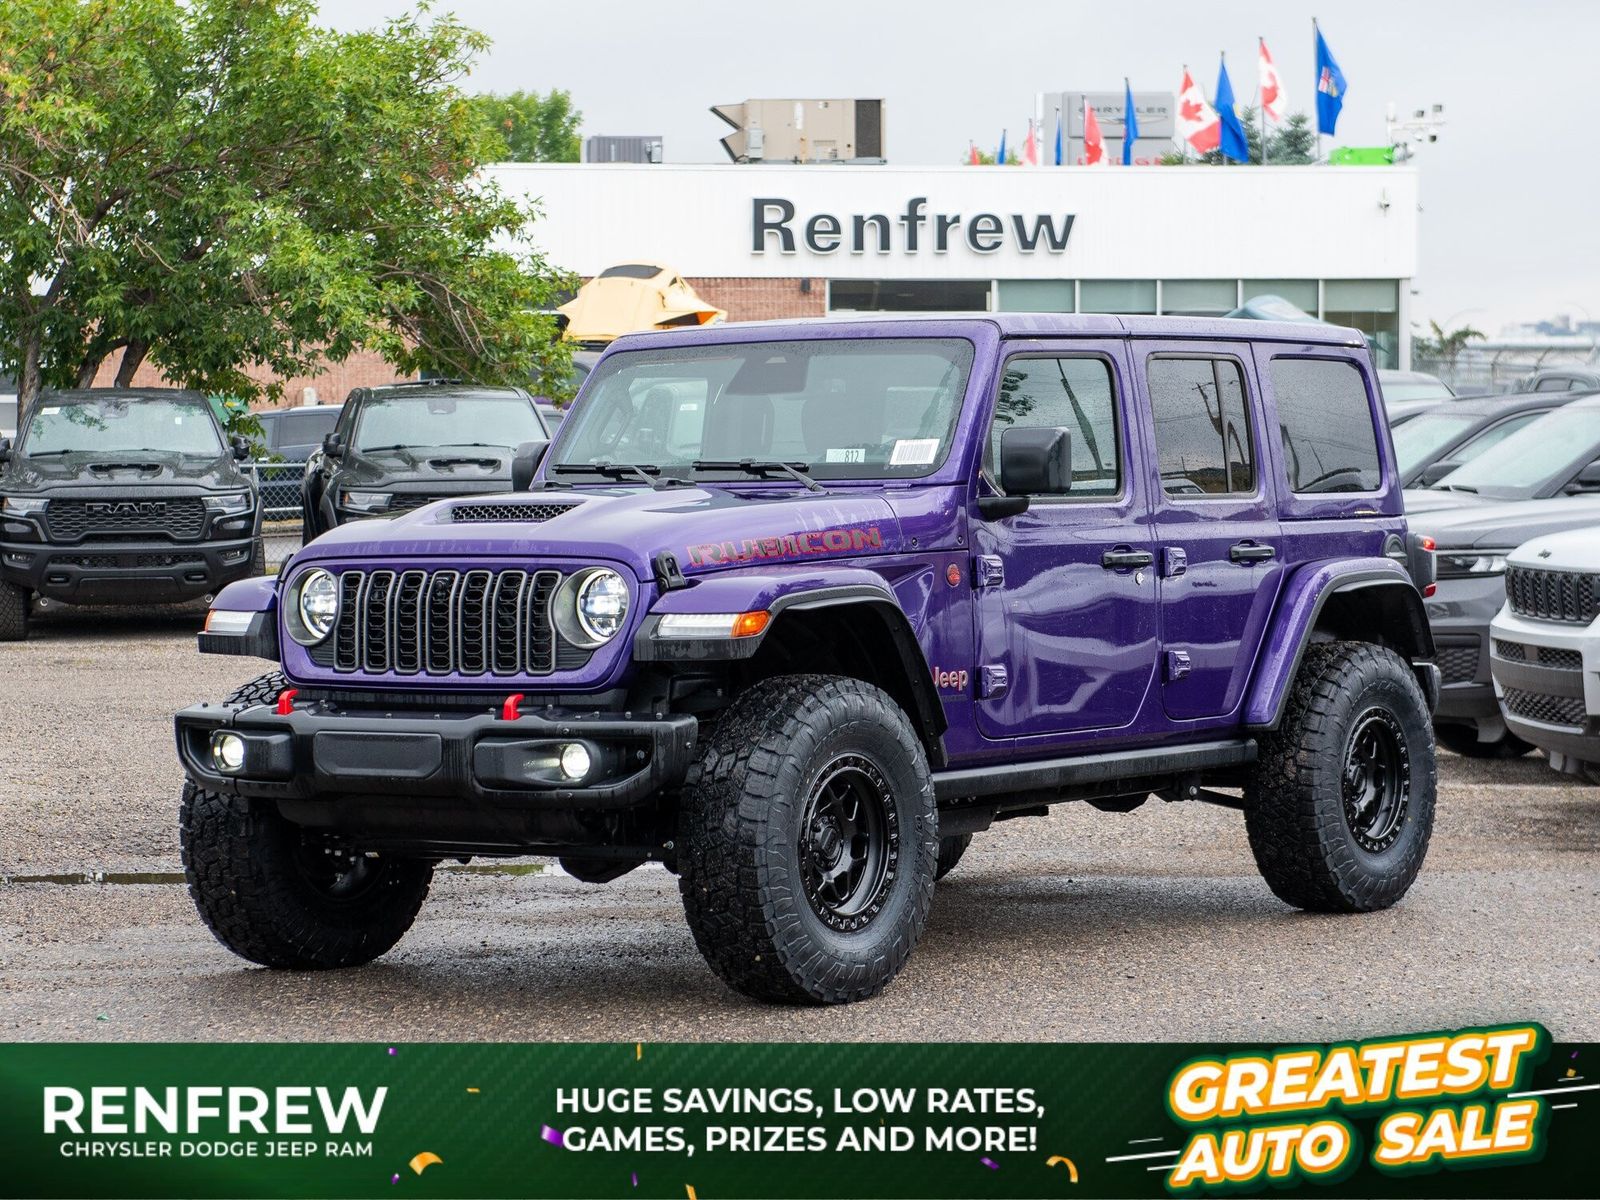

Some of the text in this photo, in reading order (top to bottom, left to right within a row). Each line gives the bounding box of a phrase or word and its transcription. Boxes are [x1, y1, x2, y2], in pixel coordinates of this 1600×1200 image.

[751, 197, 1076, 254] Renfrew
[844, 450, 860, 463] 812
[85, 502, 167, 515] RAM
[686, 527, 882, 568] RUBICON
[933, 666, 969, 691] Jeep
